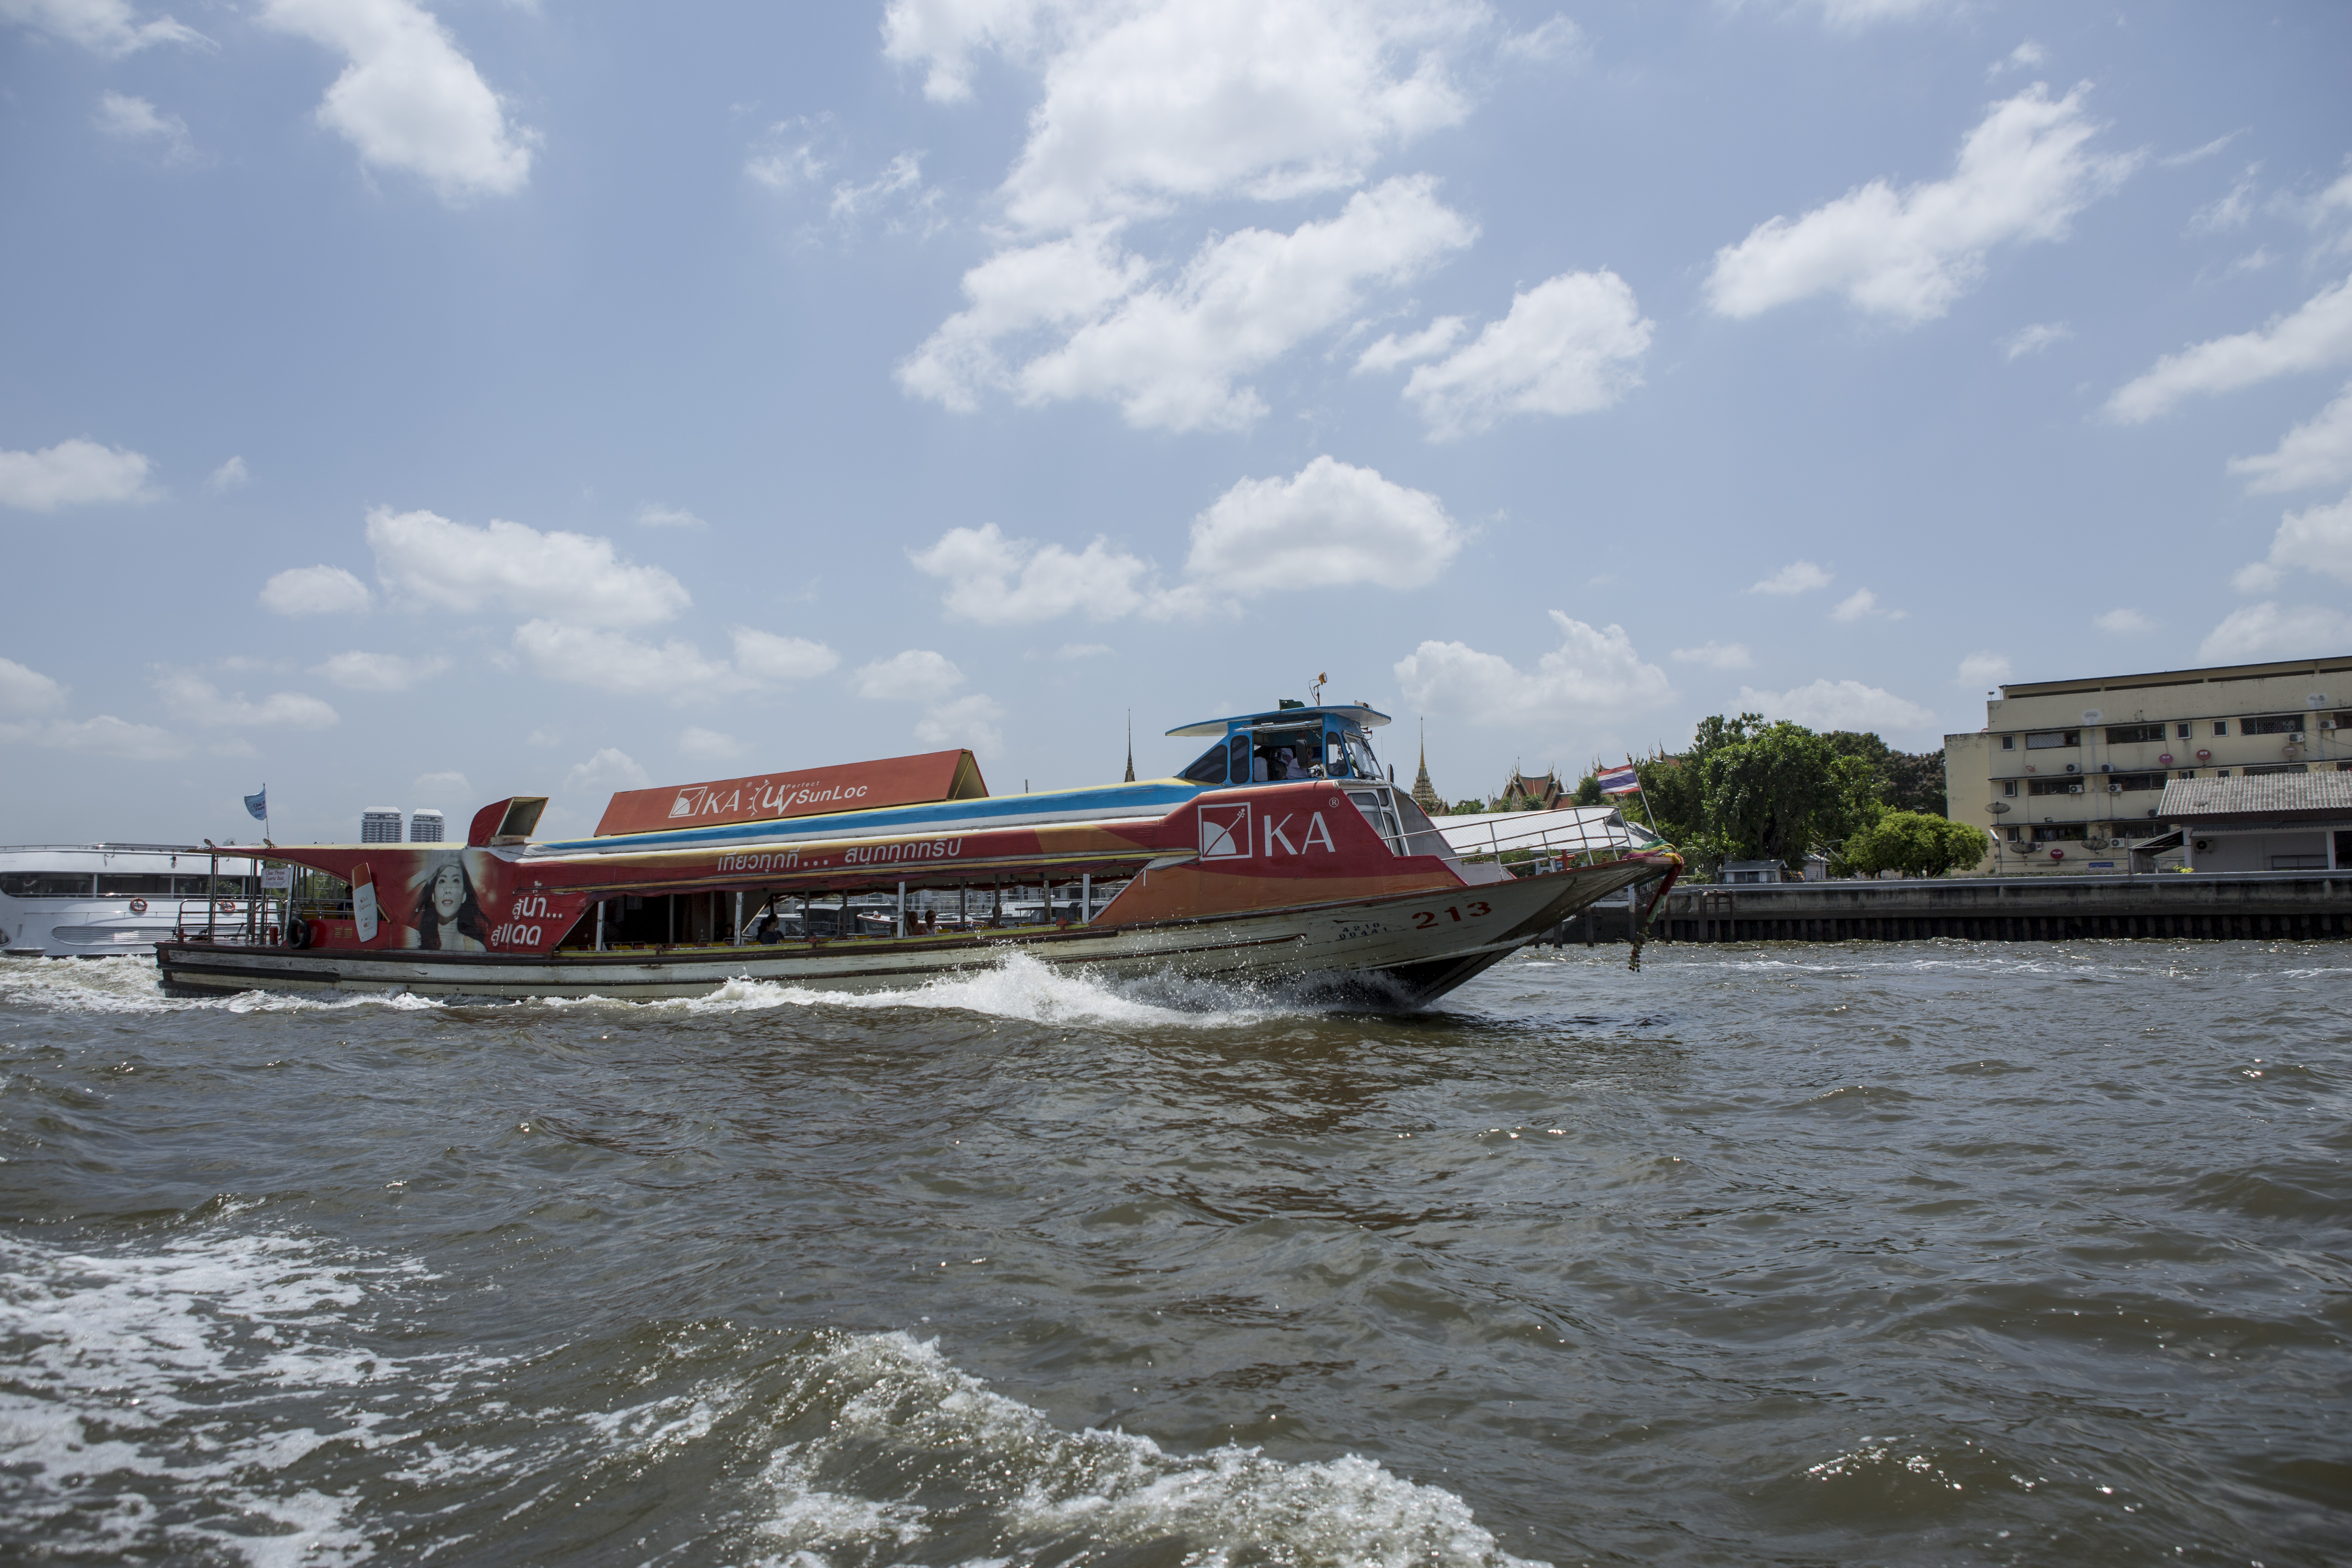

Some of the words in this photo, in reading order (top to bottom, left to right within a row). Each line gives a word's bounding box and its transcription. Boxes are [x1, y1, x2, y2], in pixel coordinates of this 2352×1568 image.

[786, 781, 820, 790] Perfect
[702, 789, 740, 815] KA
[1264, 811, 1336, 857] KA
[1342, 922, 1380, 932] 4210
[1411, 901, 1492, 930] 213
[491, 923, 541, 946] สู้แดด
[1339, 927, 1388, 939] 00441
